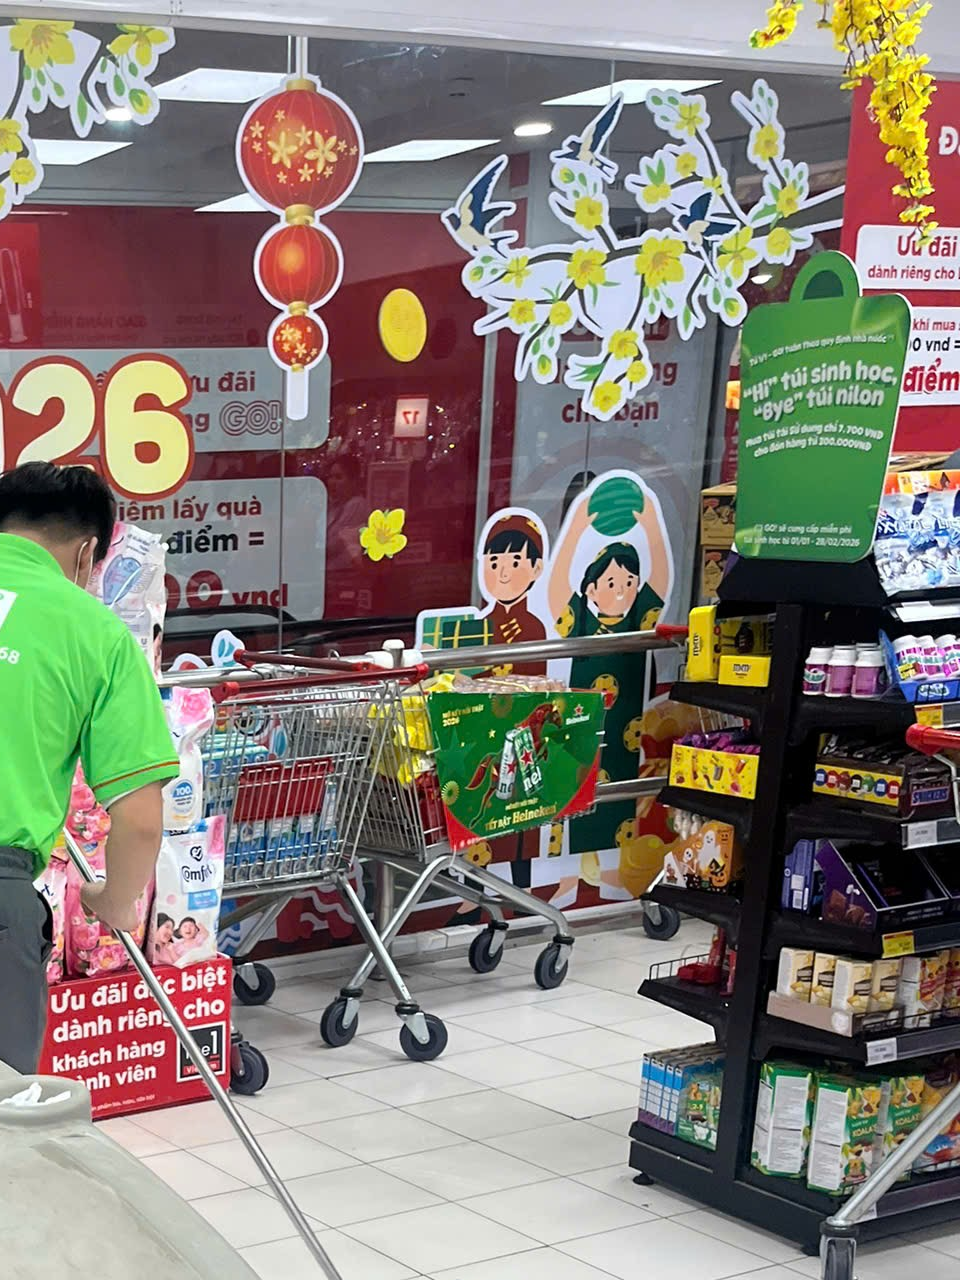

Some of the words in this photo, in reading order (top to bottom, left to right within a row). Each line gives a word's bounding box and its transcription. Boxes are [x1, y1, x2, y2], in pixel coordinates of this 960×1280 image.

[897, 231, 922, 257] Ưu
[928, 236, 957, 257] đãi
[868, 266, 898, 279] dành
[901, 265, 931, 281] riêng
[934, 266, 955, 279] cho
[912, 318, 929, 331] khi
[932, 321, 956, 331] mua
[926, 336, 951, 352] vnd
[218, 371, 256, 392] đãi
[781, 367, 808, 391] túi
[811, 360, 851, 384] sinh
[855, 360, 898, 386] học,
[903, 357, 960, 392] điểm
[806, 385, 833, 408] túi
[835, 384, 885, 407] nilon
[219, 400, 282, 436] GO!
[173, 496, 209, 522] lấy
[216, 495, 262, 519] quà
[167, 525, 239, 554] điểm
[512, 805, 557, 824] Heineken
[50, 988, 85, 1014] Ưu
[92, 982, 128, 1008] đãi
[181, 966, 227, 993] biệt
[53, 1014, 112, 1043] dành
[183, 997, 225, 1020] cho
[52, 1047, 112, 1073] khách
[116, 1039, 166, 1062] hàng
[115, 1064, 157, 1086] viên
